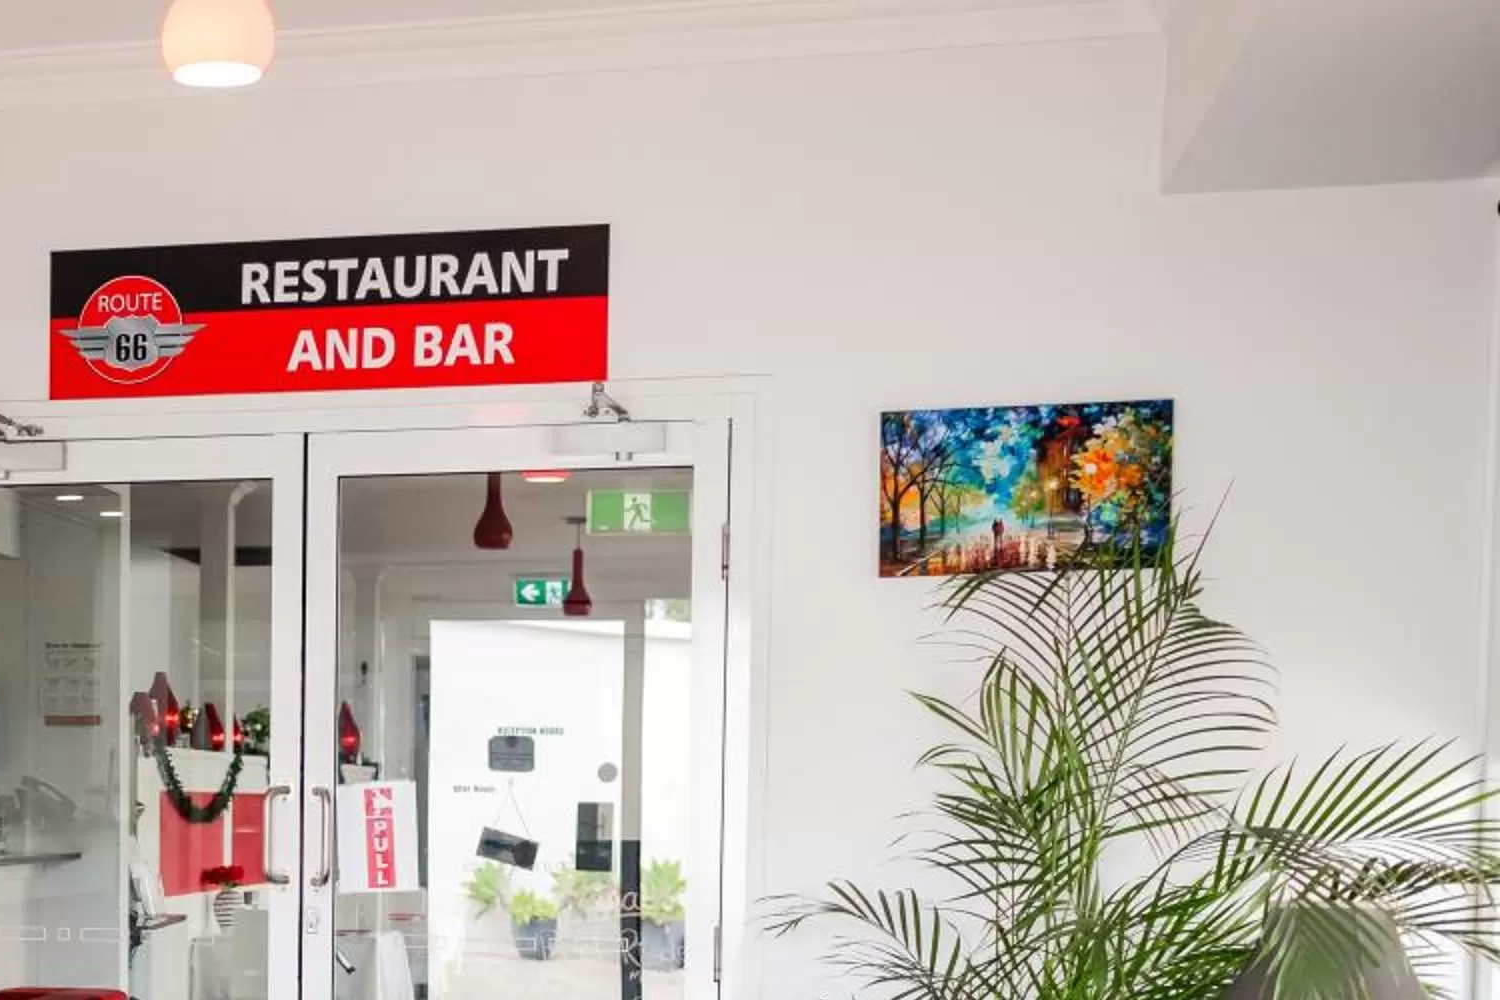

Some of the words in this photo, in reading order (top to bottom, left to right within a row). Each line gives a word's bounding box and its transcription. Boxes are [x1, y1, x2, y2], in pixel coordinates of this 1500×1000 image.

[241, 249, 569, 305] RESTAURANT
[98, 291, 162, 313] ROUTE
[114, 332, 148, 361] 66
[286, 329, 395, 372] AND
[413, 323, 515, 367] BAR
[372, 820, 389, 886] PULL
